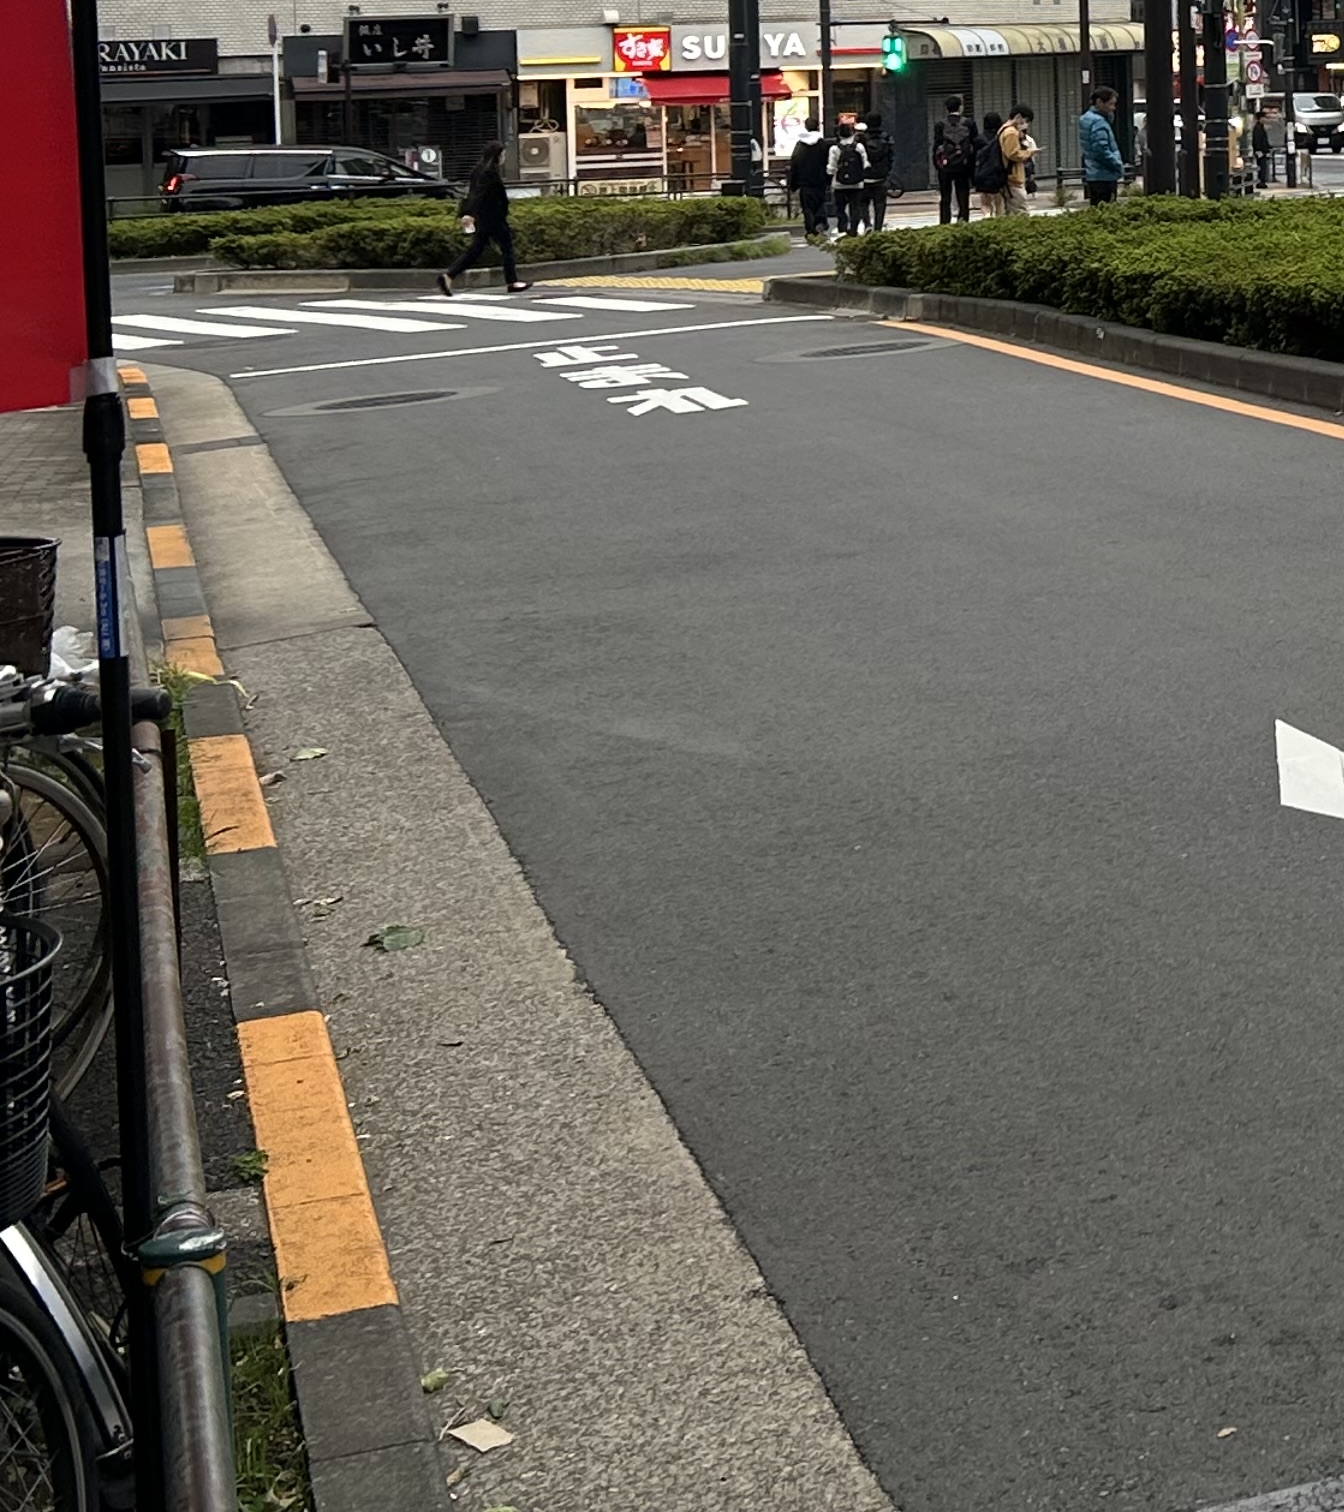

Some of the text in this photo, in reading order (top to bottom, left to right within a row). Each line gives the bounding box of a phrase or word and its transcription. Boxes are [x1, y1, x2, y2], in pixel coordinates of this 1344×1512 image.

[682, 33, 806, 61] SUYA
[533, 345, 749, 416] 止まれ
